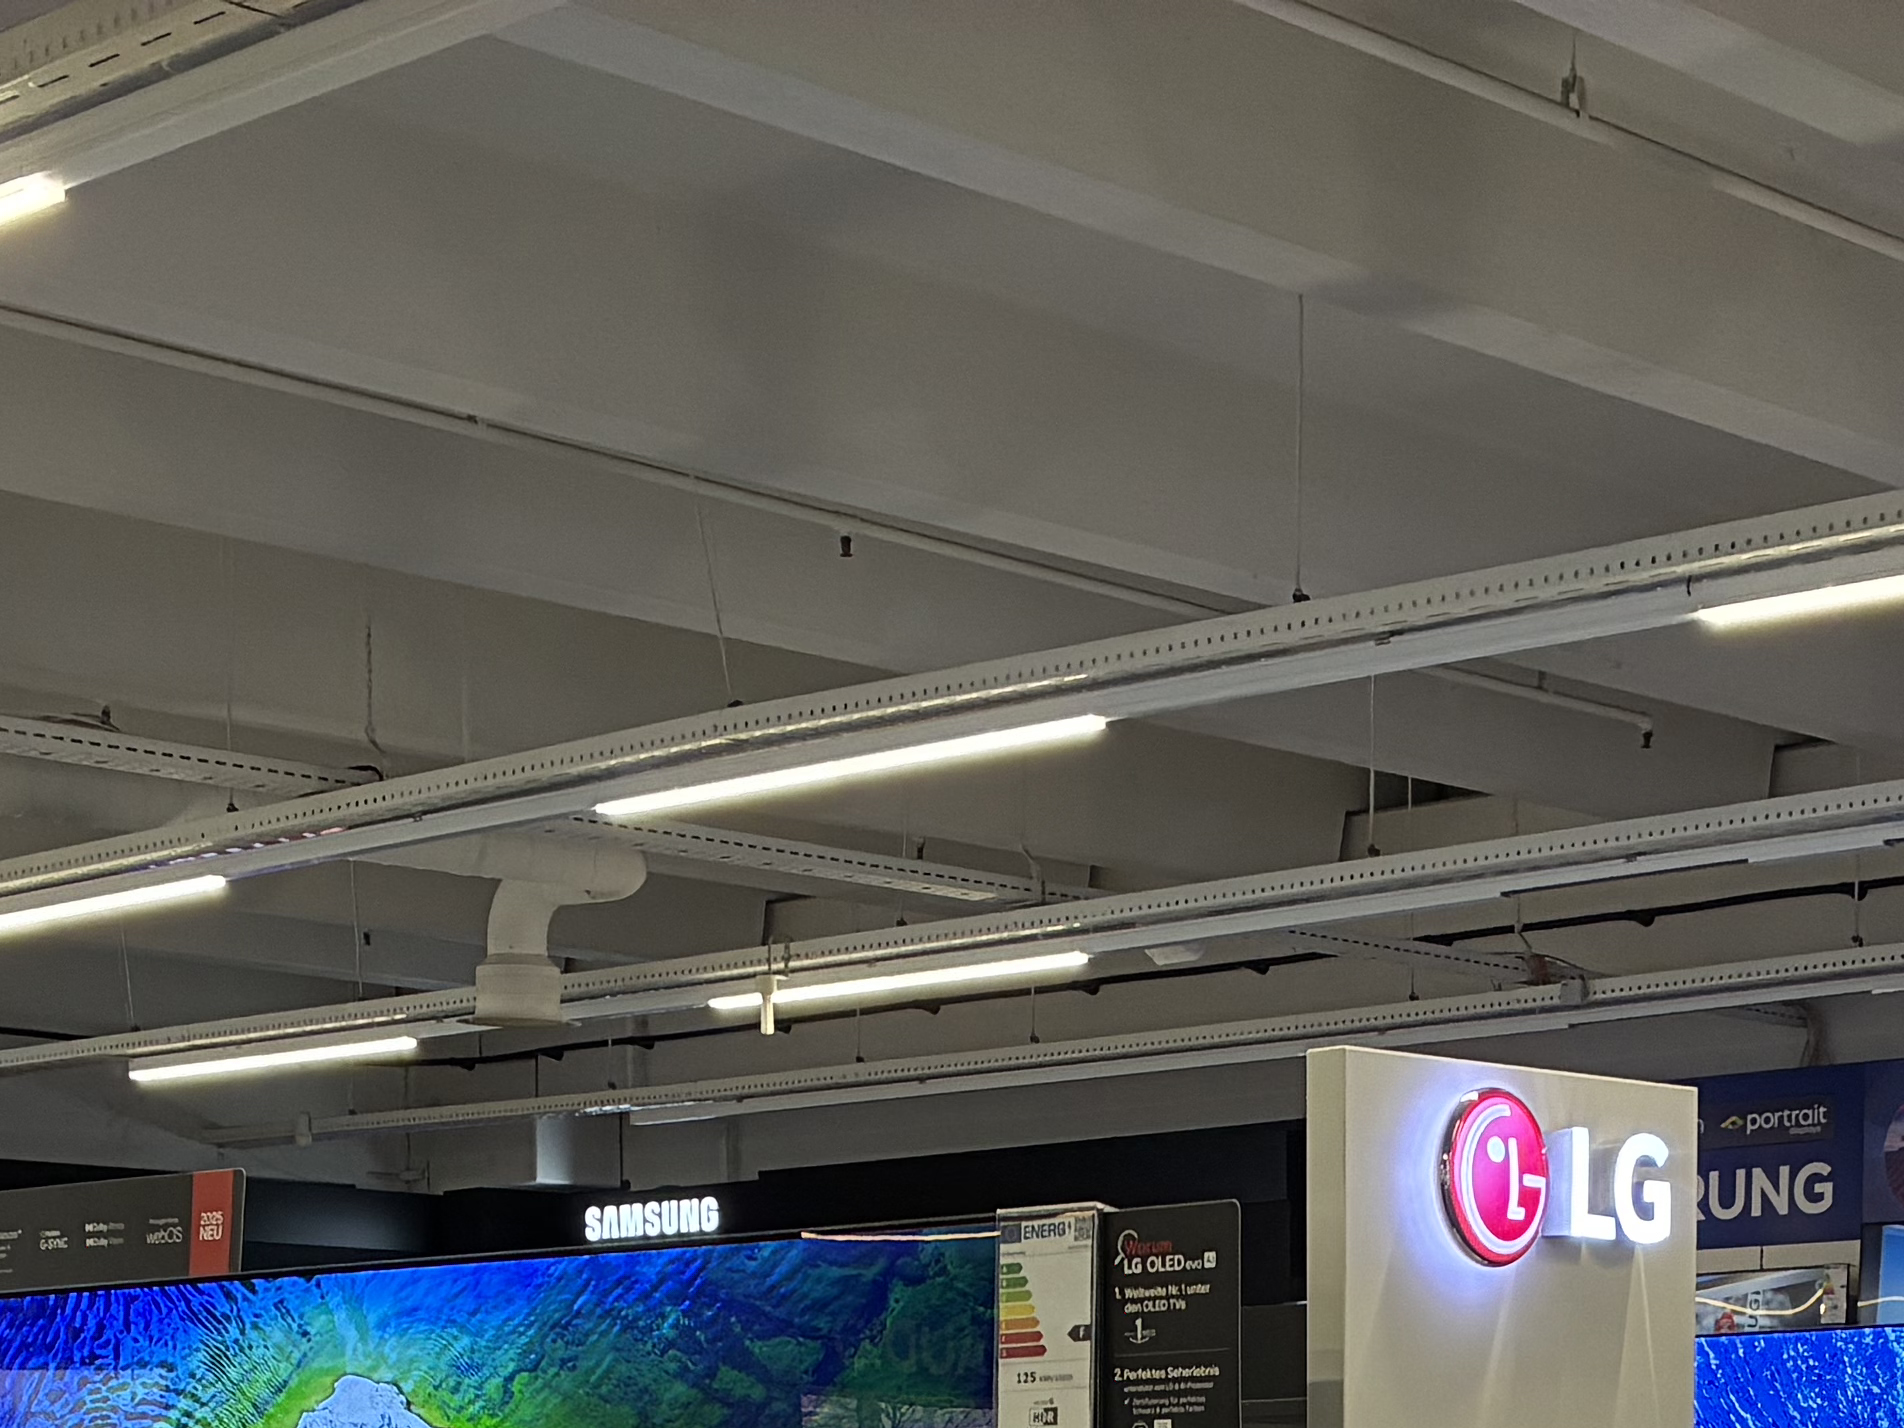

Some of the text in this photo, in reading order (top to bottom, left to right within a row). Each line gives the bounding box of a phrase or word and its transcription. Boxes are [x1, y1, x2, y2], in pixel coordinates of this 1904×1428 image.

[1747, 1104, 1827, 1134] portrait
[1556, 1125, 1673, 1245] LG
[585, 1197, 719, 1241] SAMSUNG
[147, 1226, 183, 1244] webOS
[200, 1225, 222, 1240] NEU
[1125, 1240, 1172, 1256] Warum
[1124, 1254, 1202, 1274] LG OLED evo
[1125, 1301, 1141, 1313] den
[1143, 1300, 1168, 1312] OLED
[1017, 1372, 1036, 1384] 125
[1124, 1367, 1166, 1380] Perfektes
[1168, 1364, 1220, 1378] Seherlebnis
